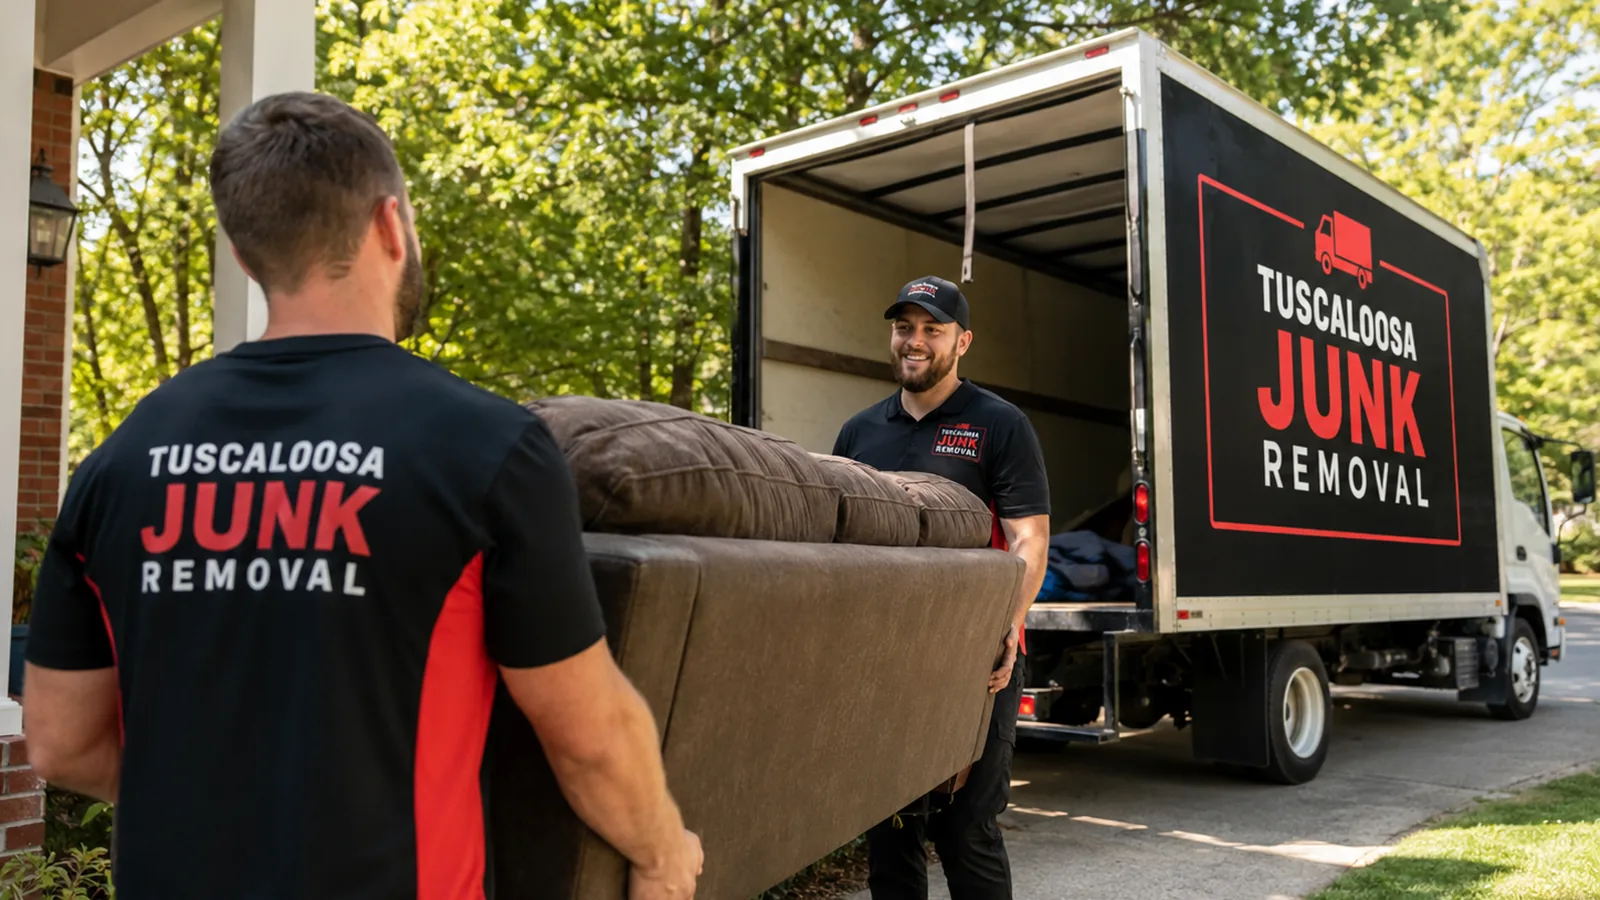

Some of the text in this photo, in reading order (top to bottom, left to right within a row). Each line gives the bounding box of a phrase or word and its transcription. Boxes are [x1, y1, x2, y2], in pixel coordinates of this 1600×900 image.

[1257, 264, 1417, 361] TUSCALOOSA
[1257, 329, 1426, 458] JUNK
[149, 440, 384, 479] TUSCALOOSA
[937, 435, 978, 449] JUNK
[1263, 440, 1429, 508] REMOVAL
[140, 480, 382, 557] JUNK
[141, 558, 366, 596] REMOVAL
